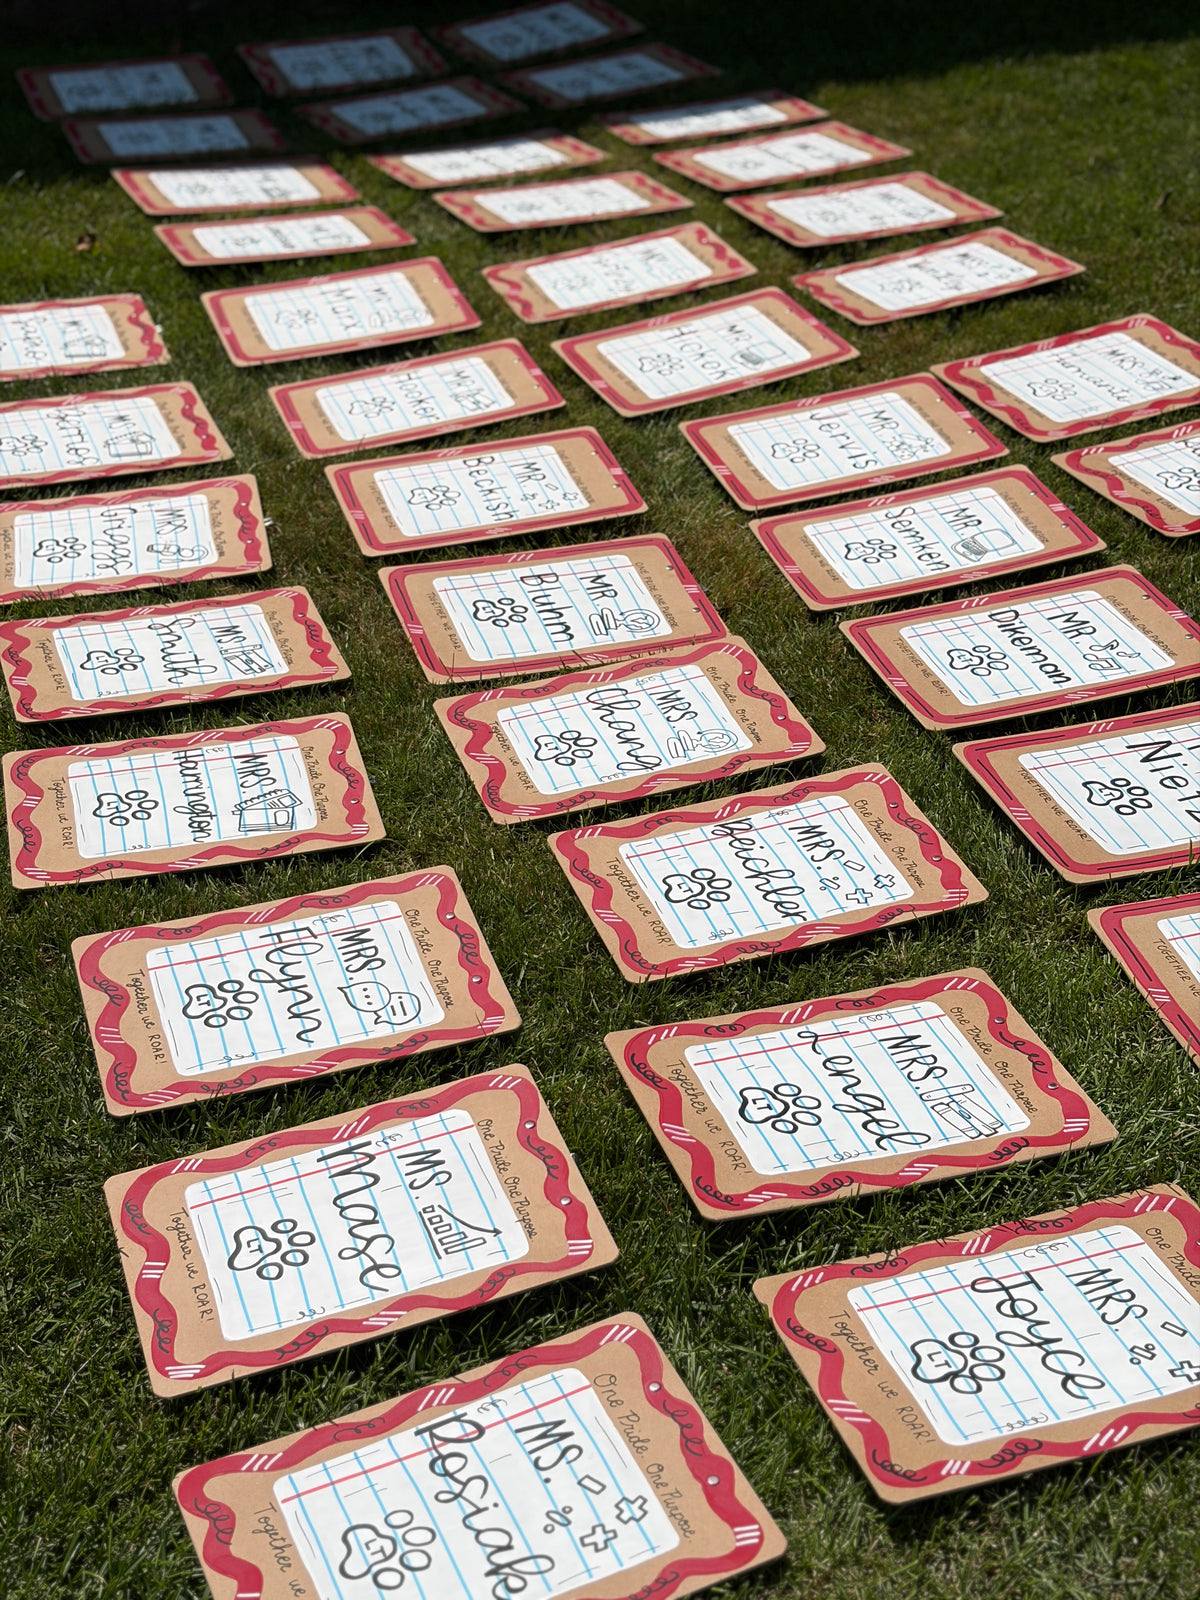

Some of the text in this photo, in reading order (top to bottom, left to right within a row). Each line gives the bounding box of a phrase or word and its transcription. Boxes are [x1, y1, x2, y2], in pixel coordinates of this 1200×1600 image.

[666, 323, 735, 381] Hickok
[394, 372, 440, 422] Hooker
[809, 411, 877, 470] Jervis
[462, 455, 519, 522] Beckish
[509, 460, 547, 488] MR.
[91, 507, 138, 575] Griggs
[154, 508, 188, 537] MRS.
[885, 506, 951, 573] Semken
[939, 507, 983, 536] MR.
[481, 605, 496, 615] LT
[520, 572, 575, 643] Bluhm
[579, 574, 618, 607] MR.
[1105, 595, 1125, 608] ONE
[1136, 623, 1154, 636] ONE
[95, 655, 109, 664] LT
[148, 617, 218, 685] Smith
[210, 624, 247, 651] MS.
[956, 654, 974, 663] LT
[987, 609, 1072, 685] Dikeman
[1048, 611, 1097, 645] MR.
[920, 668, 934, 679] WE
[586, 687, 663, 771] Chang
[649, 688, 698, 729] MRS.
[233, 754, 277, 794] MRS.
[487, 720, 539, 794] Together we ROAR!
[543, 741, 560, 751] LT
[48, 776, 74, 850] Together we ROAR!
[106, 800, 120, 812] LT
[172, 749, 214, 843] Harrington
[1017, 766, 1091, 843] TOGETHER WE ROAR!
[1098, 787, 1114, 800] LT
[710, 817, 808, 922] Beichler
[788, 824, 845, 871] MRS.
[853, 799, 873, 818] One
[891, 846, 908, 863] One
[904, 860, 926, 889] Purpose.
[606, 857, 675, 947] Together we ROAR!
[676, 881, 694, 894] LT
[248, 926, 323, 1044] Flynn
[332, 927, 387, 981] MRS.
[404, 908, 455, 1009] One Pride. One Purpose.
[1153, 937, 1191, 983] TOGETHER
[127, 968, 168, 1064] Together we ROAR!
[195, 993, 212, 1007] LT
[797, 1030, 931, 1151] Lengel
[878, 1034, 948, 1090] MRS.
[949, 1006, 1039, 1114] One Pride. One Purpose.
[666, 1059, 753, 1174] Together we ROAR!
[751, 1097, 773, 1111] LT
[396, 1148, 453, 1200] MS.
[476, 1118, 538, 1240] One Pride. One Purpose.
[246, 1237, 264, 1254] LT
[317, 1140, 403, 1292] Mase
[168, 1206, 215, 1322] Together we ROAR!
[1145, 1227, 1200, 1292] One Pride.
[1065, 1267, 1149, 1333] MRS.
[926, 1350, 953, 1369] LT
[970, 1271, 1106, 1401] Joyce
[828, 1309, 937, 1444] Together we ROAR!
[514, 1419, 583, 1484] MS.
[593, 1373, 696, 1539] One Pride. One Purpose.
[415, 1412, 555, 1600] Rosiak
[253, 1501, 307, 1598] Together we
[364, 1534, 391, 1562] LT
